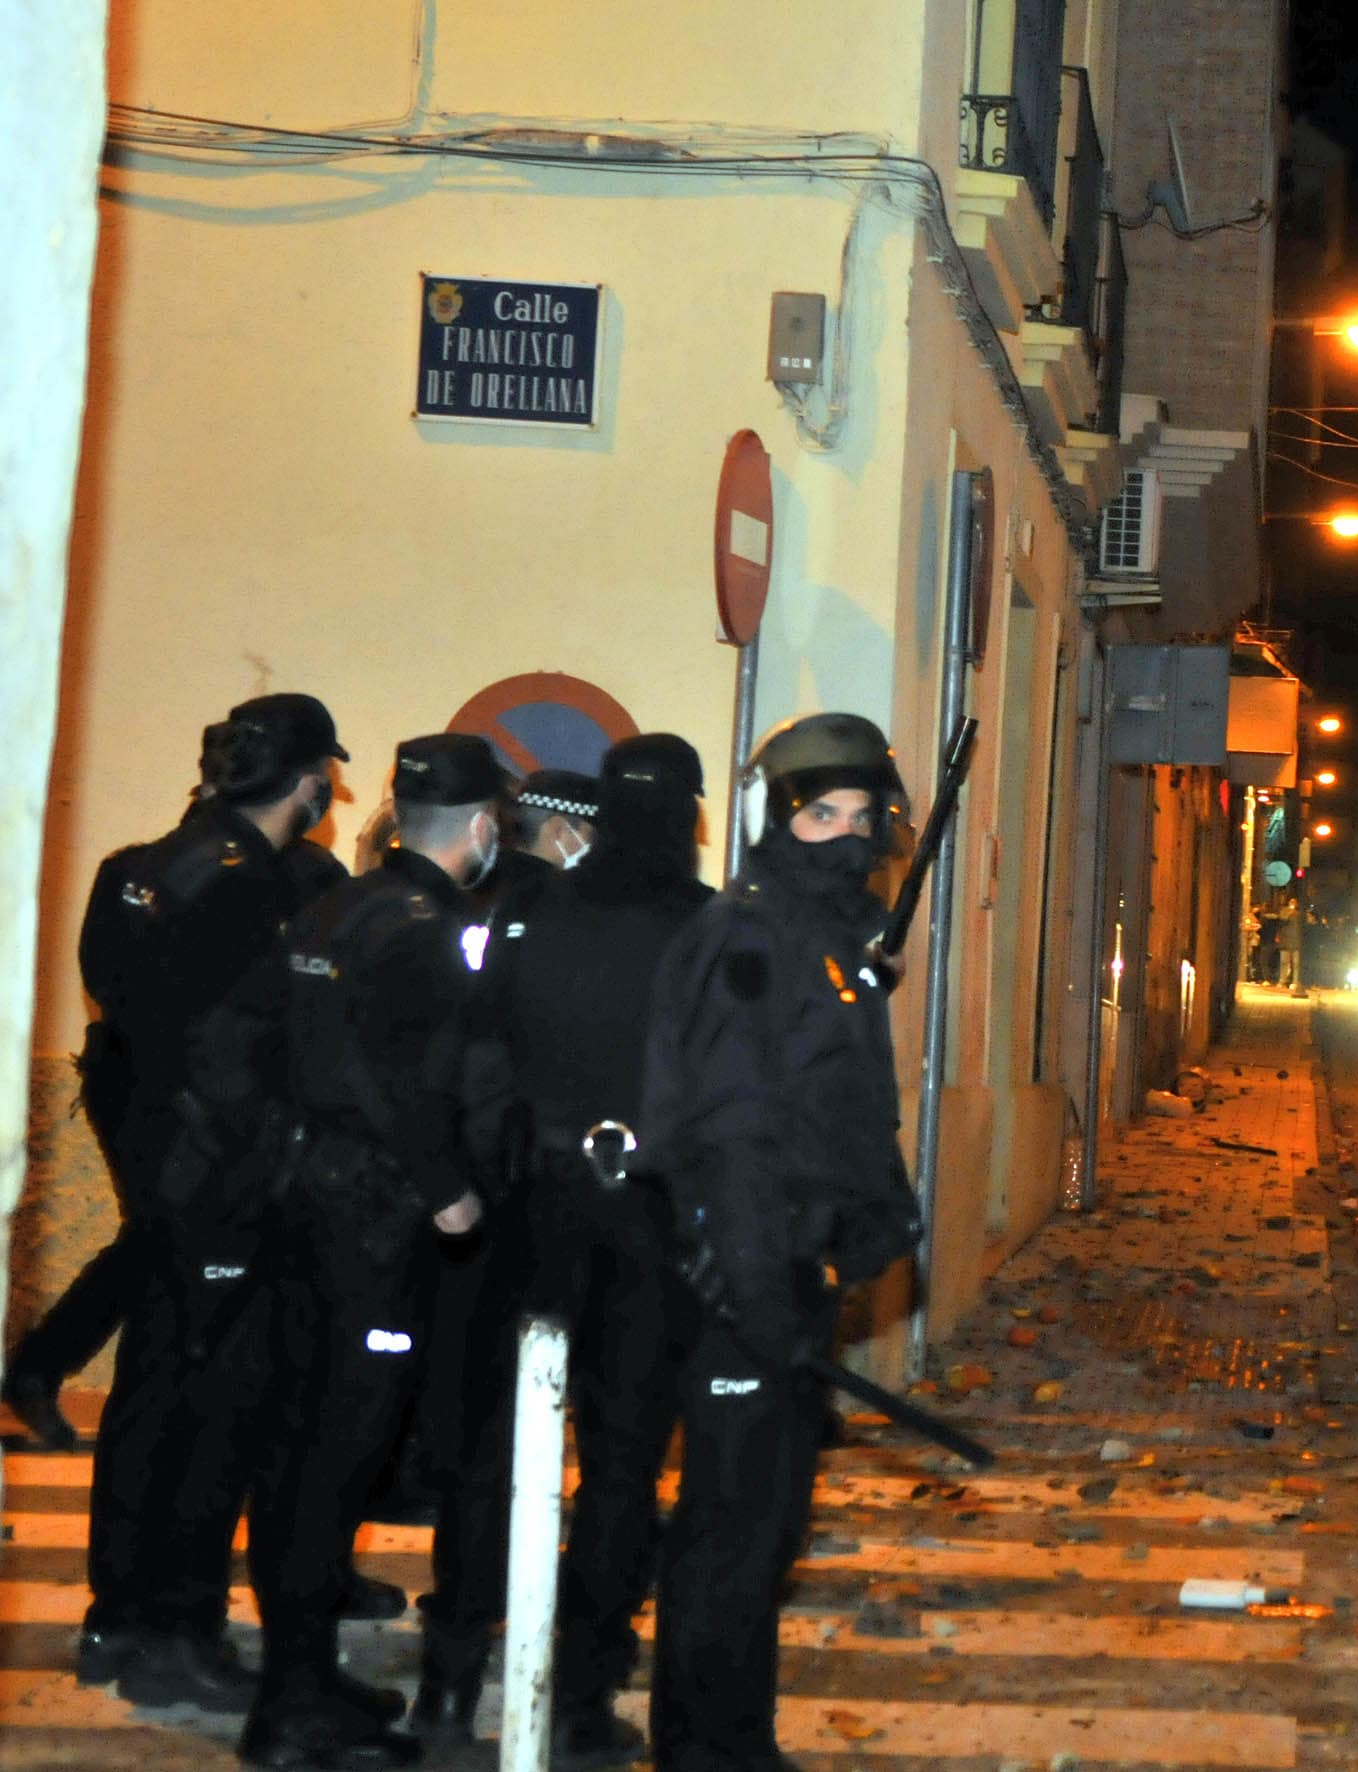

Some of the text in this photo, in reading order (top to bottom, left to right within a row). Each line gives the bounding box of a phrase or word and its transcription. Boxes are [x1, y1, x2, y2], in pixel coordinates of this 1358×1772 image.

[494, 291, 568, 323] Calle
[442, 326, 574, 368] FRANCISCO
[426, 370, 587, 413] DE ORELLANA
[711, 1378, 760, 1395] CNP
